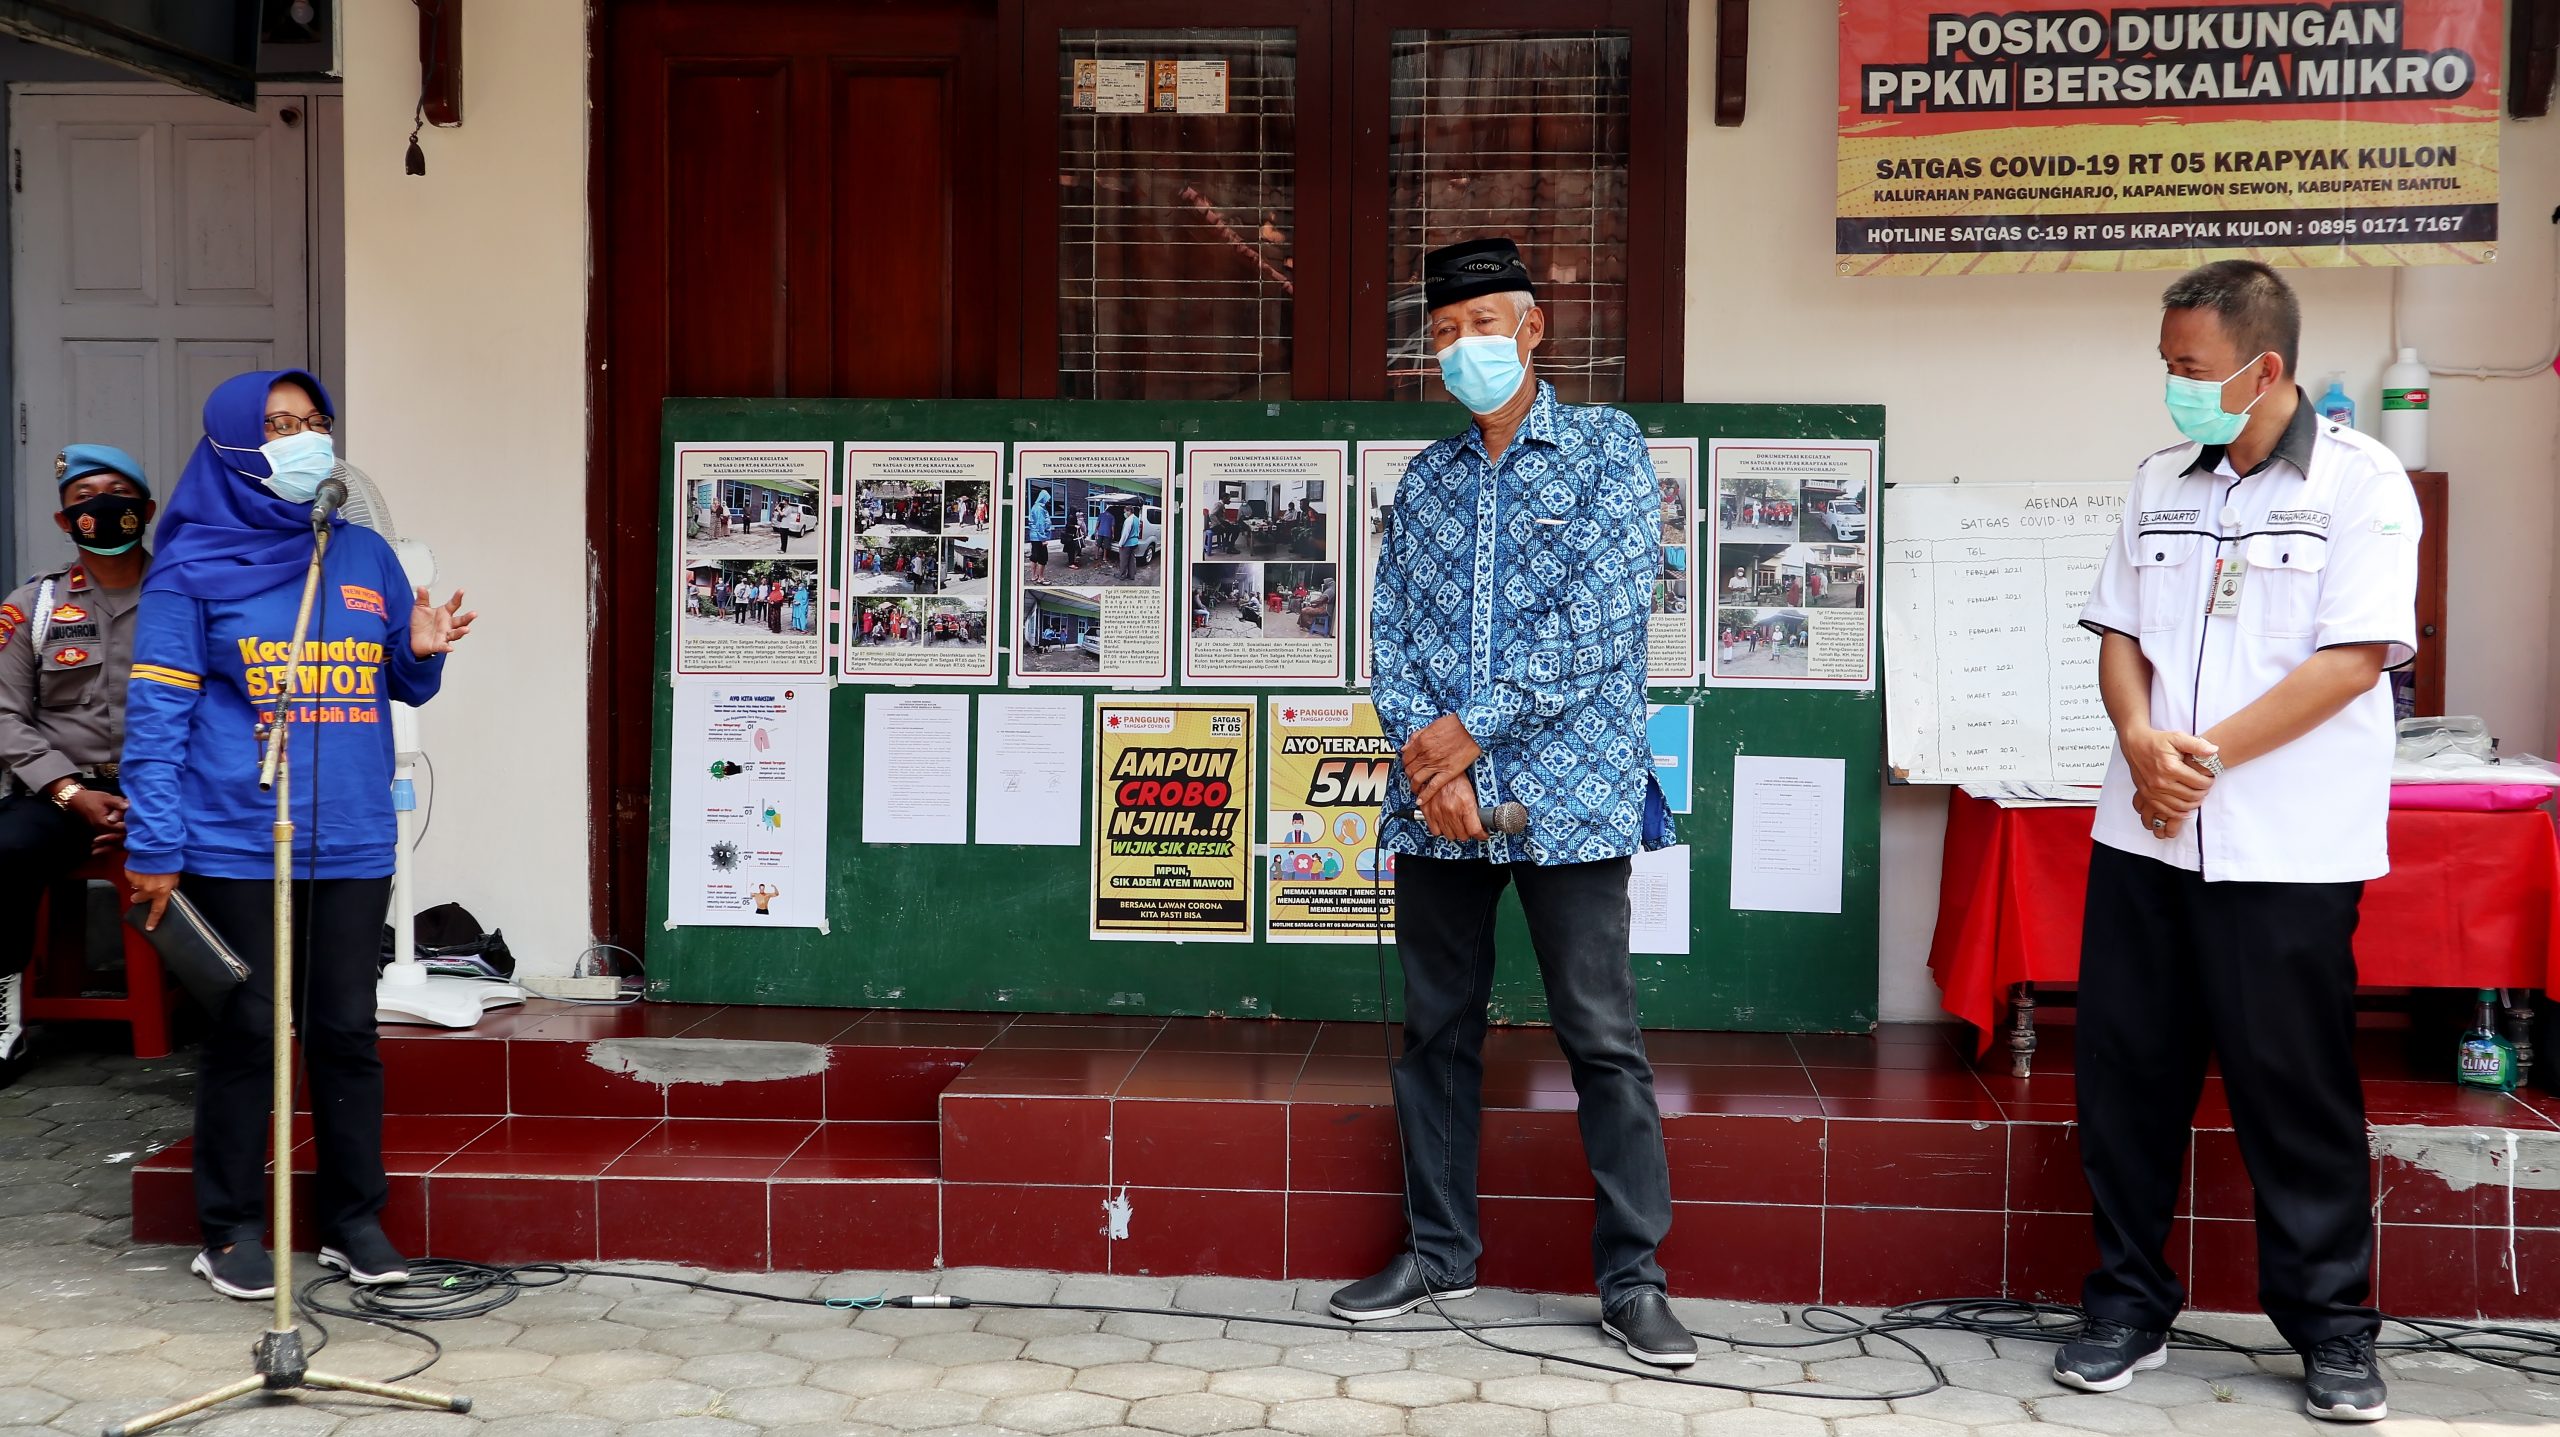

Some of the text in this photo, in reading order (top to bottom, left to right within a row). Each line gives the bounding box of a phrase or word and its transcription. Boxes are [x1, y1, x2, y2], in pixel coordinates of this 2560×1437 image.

[1936, 7, 2396, 56] POSKO DUKUNGAN
[1868, 55, 2468, 106] PPKM BERSKALA MIKRO
[1876, 146, 2457, 180] SATGAS COVID-19 RT 05 KRAPYAK KULON
[1874, 177, 2461, 203] KALURAHAN PANGGUNGHARJO, KAPANEWON SEWON, KABUPATEN BANTUL
[1867, 227, 1946, 243] HOTLINE
[1950, 226, 2022, 243] SATGAS
[2027, 225, 2068, 241] C-19
[2074, 225, 2097, 240] RT
[2102, 224, 2125, 239] 05
[2130, 222, 2221, 239] KRAPYAK
[2226, 220, 2292, 237] KULON
[2308, 218, 2357, 235] 0895
[2362, 217, 2409, 234] 0171
[2415, 216, 2464, 232] 7167
[2025, 497, 2078, 510] AGENDA
[1960, 513, 2122, 530] SATGAS COVID-19 RT 05
[2151, 512, 2197, 522] JANUARTO
[1904, 549, 1923, 559] NO
[2004, 566, 2022, 574] 2021
[2004, 593, 2021, 601] 2021
[238, 637, 384, 664] Kecmatan
[1123, 716, 1170, 724] PANGGUNG
[1300, 709, 1349, 717] PANGGUNG
[1212, 724, 1241, 732] RT 05
[1967, 720, 1992, 728] MARET
[1283, 738, 1320, 753] AYO
[1116, 751, 1232, 777] AMPUN
[1311, 761, 1390, 802] 5M
[1119, 781, 1228, 807] CROBO
[1112, 811, 1234, 837] NJIIH..!!
[1112, 841, 1233, 856] WIJIK SIK RESIK
[1156, 866, 1190, 877] MPUN,
[1112, 878, 1232, 888] SIK ADEM AYEM MAWON
[1120, 901, 1223, 910] BERSAMA LAWAN CORONA
[1140, 910, 1202, 919] KITA PASTI BISA
[2461, 1055, 2500, 1071] CLING
